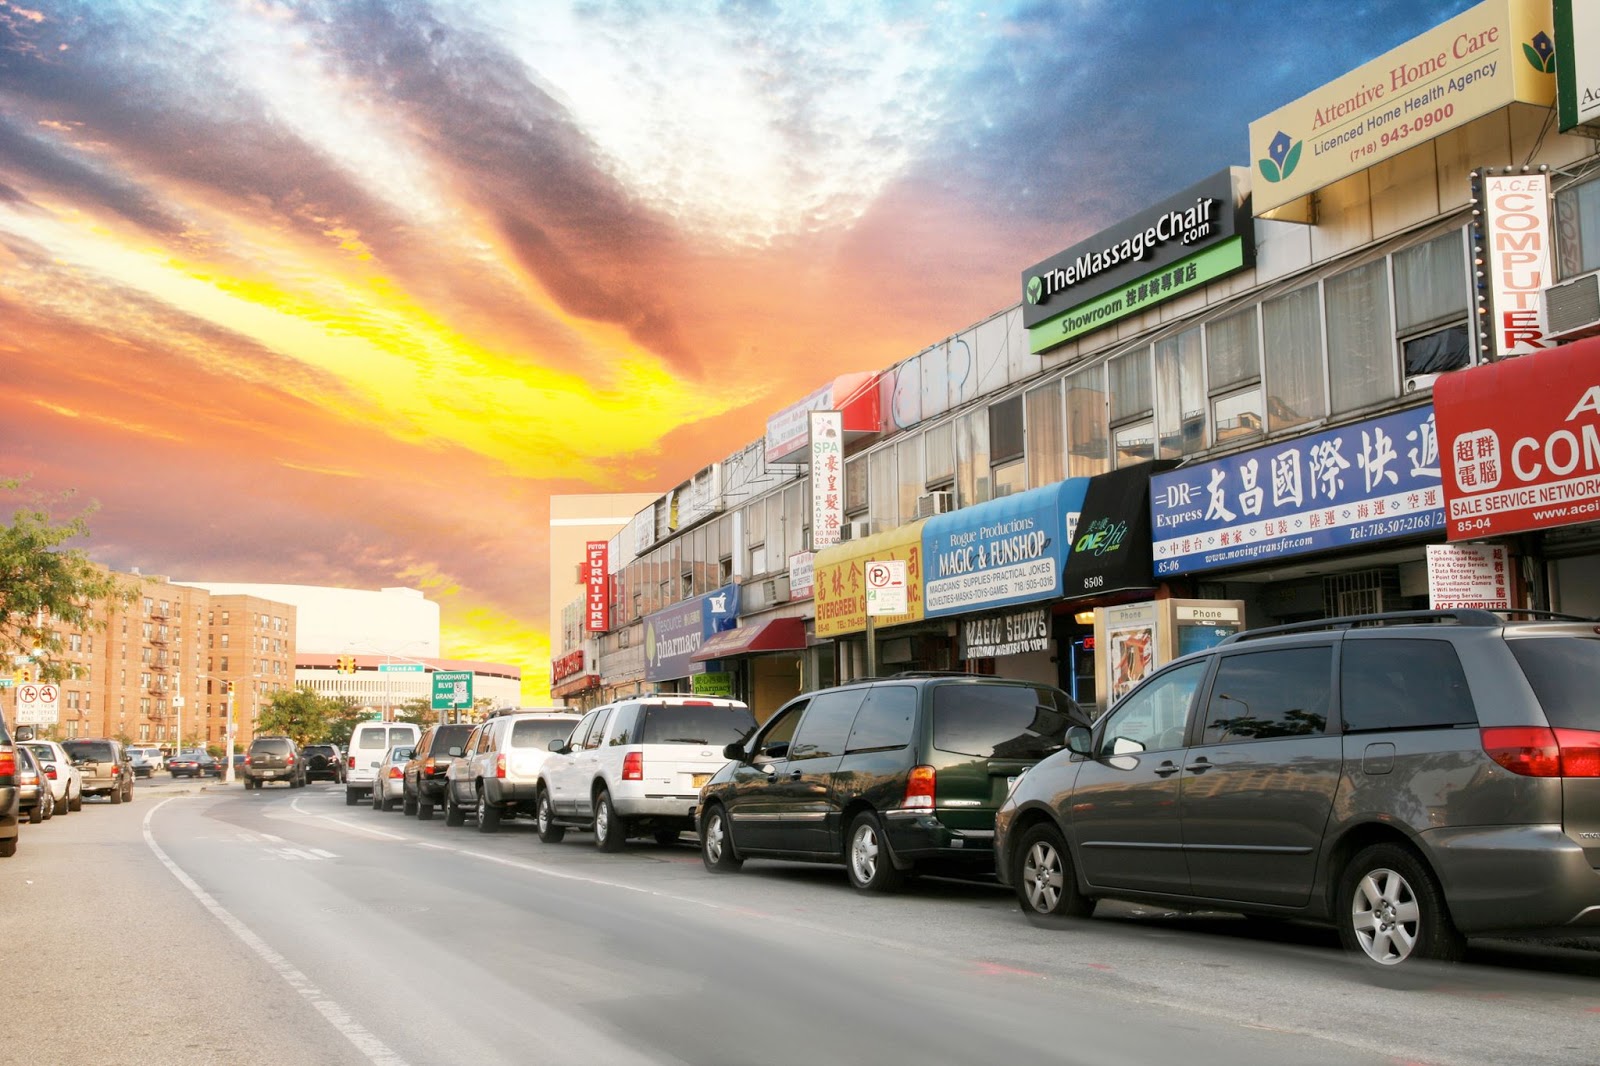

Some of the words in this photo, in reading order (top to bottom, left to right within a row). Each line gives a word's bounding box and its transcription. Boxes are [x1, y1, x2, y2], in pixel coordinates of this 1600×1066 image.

[1312, 82, 1384, 131] Attentive
[1390, 51, 1448, 92] Home
[1452, 25, 1500, 60] Care
[1314, 121, 1364, 156] Licenced
[1367, 104, 1401, 132] Home
[1404, 85, 1445, 114] Health
[1447, 61, 1498, 95] Agency
[1350, 141, 1377, 162] (718)
[1380, 103, 1454, 148] 943-0900
[1490, 179, 1542, 192] A.C.E.
[1044, 198, 1213, 295] TheMassageChair
[1180, 222, 1210, 246] .com
[1495, 193, 1546, 349] COMPUTER
[1062, 298, 1122, 334] Showroom
[814, 441, 839, 454] SPA
[1452, 499, 1482, 516] SALE
[1485, 489, 1536, 511] SERVICE
[1156, 508, 1202, 528] Express
[1457, 517, 1491, 532] 85-04
[826, 528, 840, 536] MIN
[950, 531, 977, 548] Rogue
[979, 517, 1034, 540] Productions
[939, 546, 974, 577] MAGIC
[978, 545, 987, 568] &
[990, 530, 1045, 567] FUNSHOP
[1158, 560, 1179, 573] 85-06
[1205, 536, 1313, 563] www.movingtransfer.com
[1028, 562, 1051, 576] JOKES
[591, 551, 603, 628] FURNITURE
[1084, 575, 1104, 589] 8508
[817, 597, 857, 620] EVERGREEN
[1120, 611, 1141, 619] Phone
[1193, 610, 1222, 618] Phone
[966, 617, 1002, 646] MAGIC
[1006, 609, 1047, 641] SHOWS
[1030, 637, 1048, 651] 11PM
